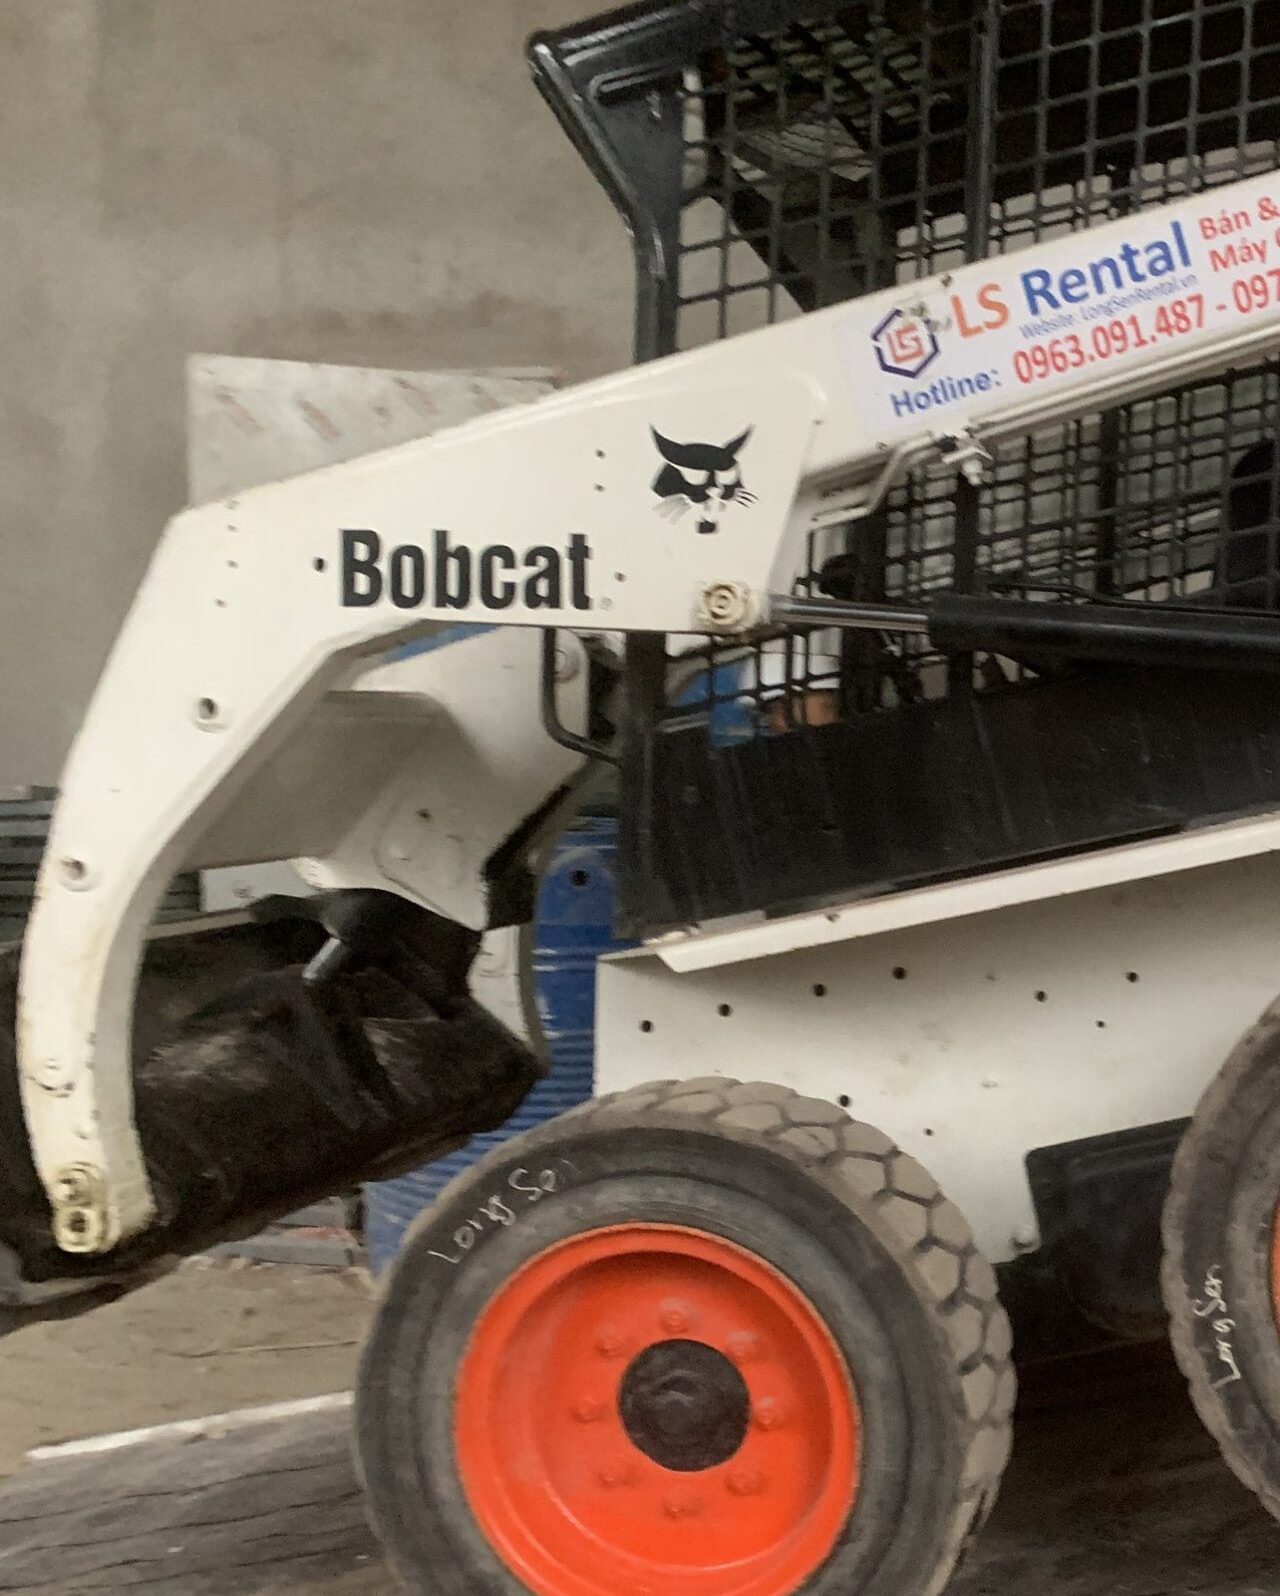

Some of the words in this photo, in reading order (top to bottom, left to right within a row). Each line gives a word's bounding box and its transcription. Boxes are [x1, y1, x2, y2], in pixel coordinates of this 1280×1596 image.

[951, 283, 1010, 339] LS
[1020, 220, 1191, 315] Rental
[890, 368, 1002, 417] Hotline:
[1013, 293, 1205, 383] 0963.091.487
[340, 528, 593, 610] Bobcat
